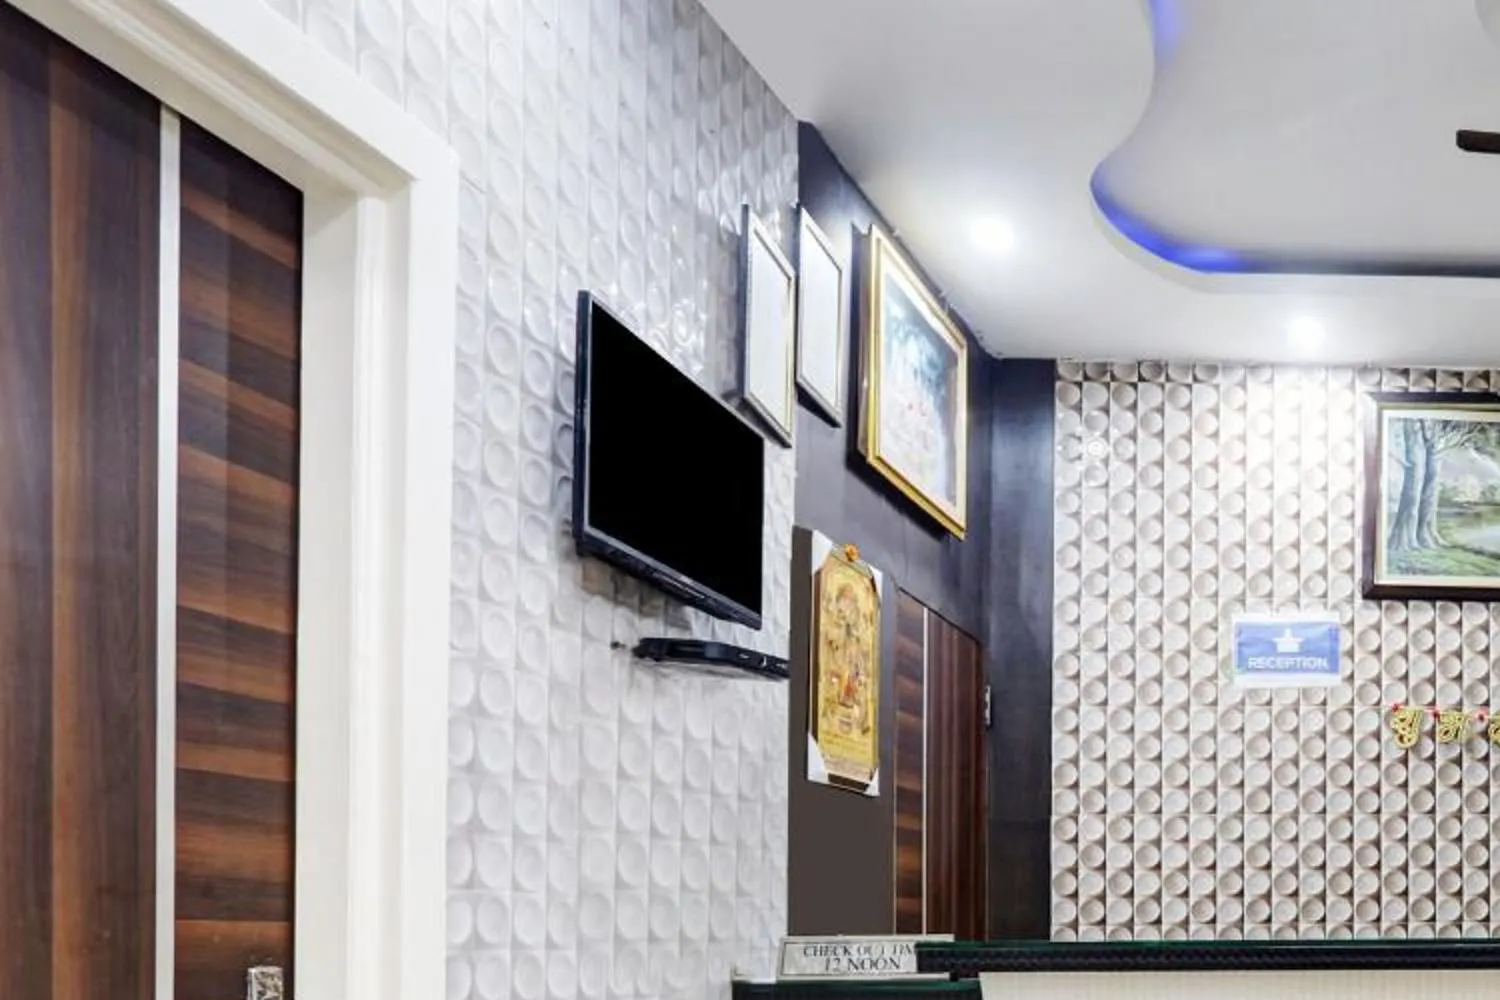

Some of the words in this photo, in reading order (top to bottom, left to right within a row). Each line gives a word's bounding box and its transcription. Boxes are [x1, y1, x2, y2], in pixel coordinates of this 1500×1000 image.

[1247, 656, 1330, 669] RECEPTION
[803, 944, 852, 958] CHECK
[857, 943, 887, 956] OUT
[825, 958, 841, 972] 12
[847, 956, 902, 972] NOON
